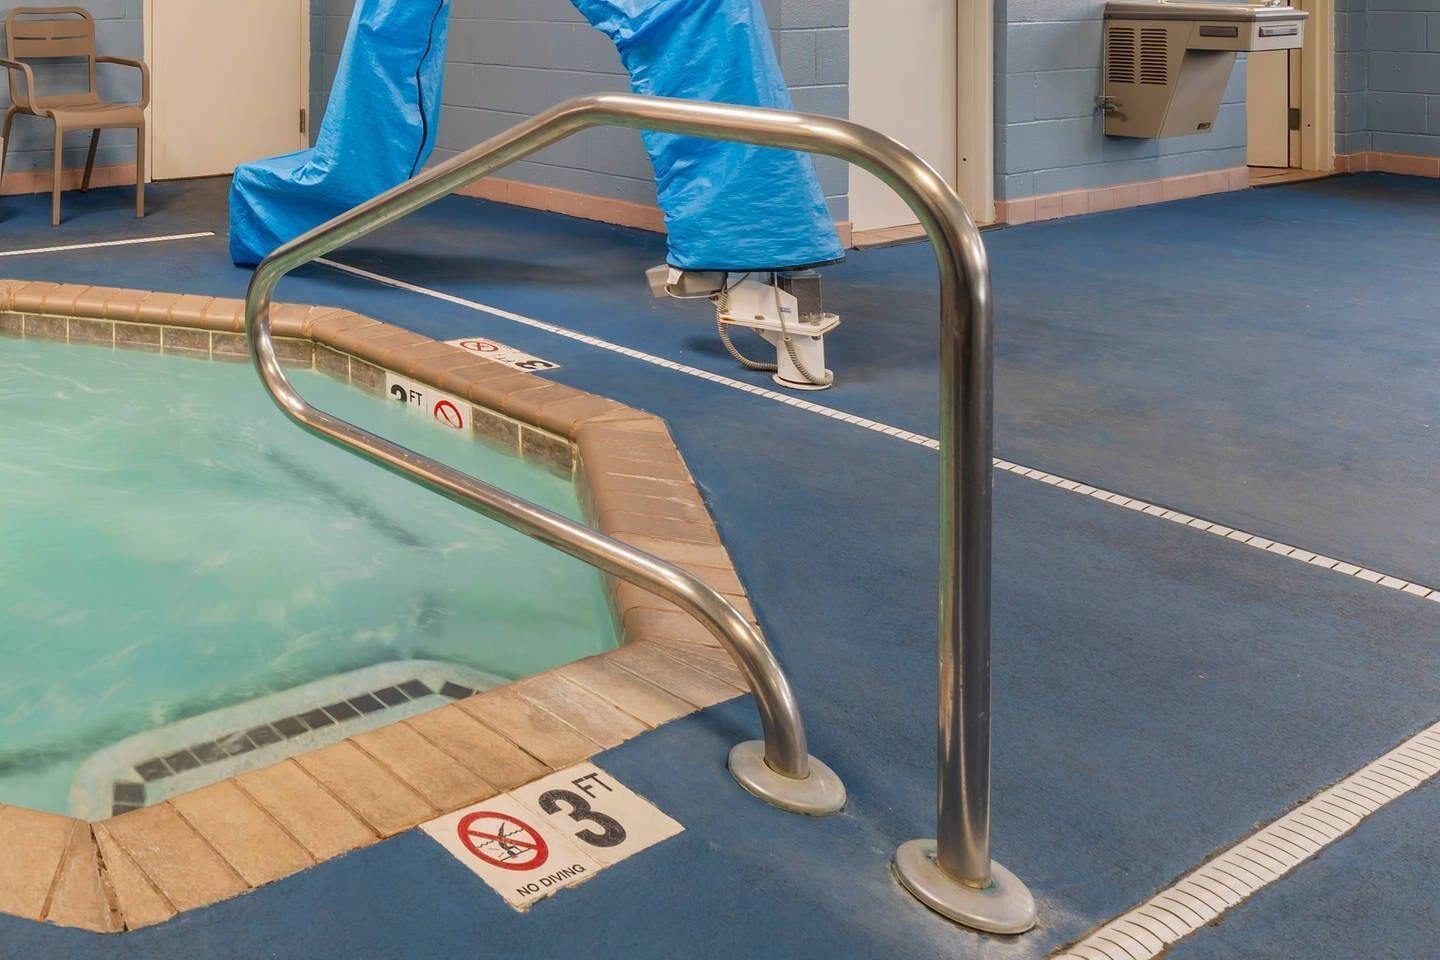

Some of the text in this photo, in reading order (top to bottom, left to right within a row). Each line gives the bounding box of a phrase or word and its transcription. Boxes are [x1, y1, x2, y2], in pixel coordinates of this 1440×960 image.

[409, 389, 423, 407] FT
[538, 772, 627, 848] 3 FT
[516, 863, 587, 897] NO DIVING
